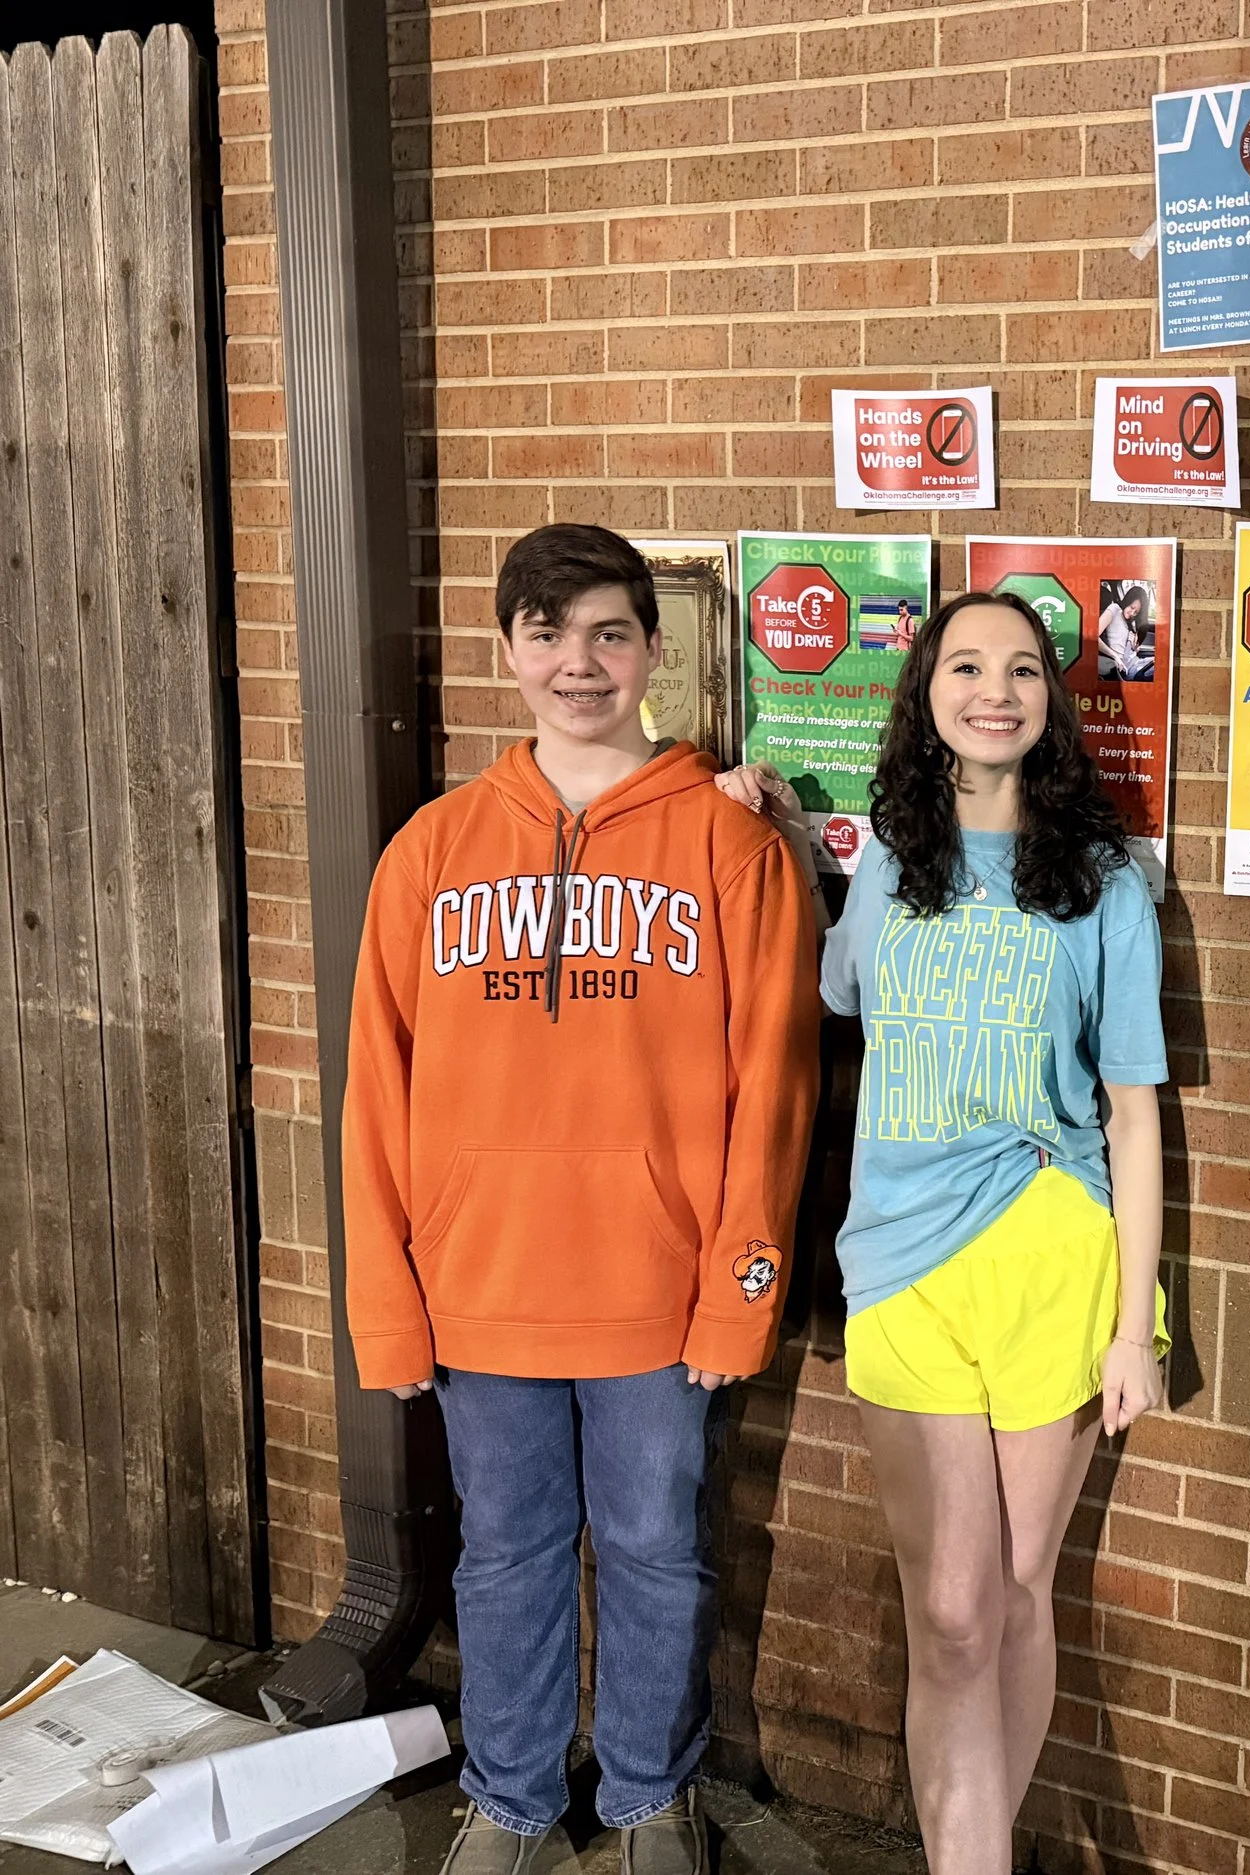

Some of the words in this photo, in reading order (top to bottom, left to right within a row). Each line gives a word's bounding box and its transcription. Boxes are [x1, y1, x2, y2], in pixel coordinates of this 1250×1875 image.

[1166, 199, 1212, 216] HOSA:
[1166, 236, 1232, 255] Students
[1119, 395, 1164, 414] Mind
[859, 408, 922, 424] Hands
[1118, 420, 1142, 434] on
[860, 433, 885, 446] on
[889, 430, 921, 446] the
[1118, 437, 1182, 462] Driving
[861, 452, 922, 469] Wheel
[922, 476, 937, 485] It's
[939, 476, 955, 485] the
[957, 474, 978, 485] Law!
[1174, 470, 1189, 480] It's
[1190, 470, 1205, 480] the
[1206, 471, 1225, 481] Law!
[863, 491, 960, 501] OklahomaChallenge.org
[1117, 485, 1209, 497] OklahomaChallenge.org
[750, 678, 815, 696] Check
[822, 680, 864, 698] Your
[1097, 695, 1123, 718] Up
[757, 713, 805, 724] Prioritize
[807, 717, 859, 729] messages
[1105, 723, 1114, 734] in
[1116, 724, 1133, 735] the
[1135, 726, 1155, 736] car.
[767, 736, 792, 748] Only
[794, 738, 836, 751] respond
[839, 739, 847, 748] if
[848, 740, 871, 754] truly
[1099, 747, 1128, 761] Every
[1129, 749, 1154, 759] seat.
[803, 760, 857, 775] Everything
[1098, 770, 1125, 782] Every
[1128, 771, 1153, 783] time.
[432, 873, 700, 976] COWBOYS
[482, 971, 544, 1000] EST
[570, 970, 638, 999] 1890
